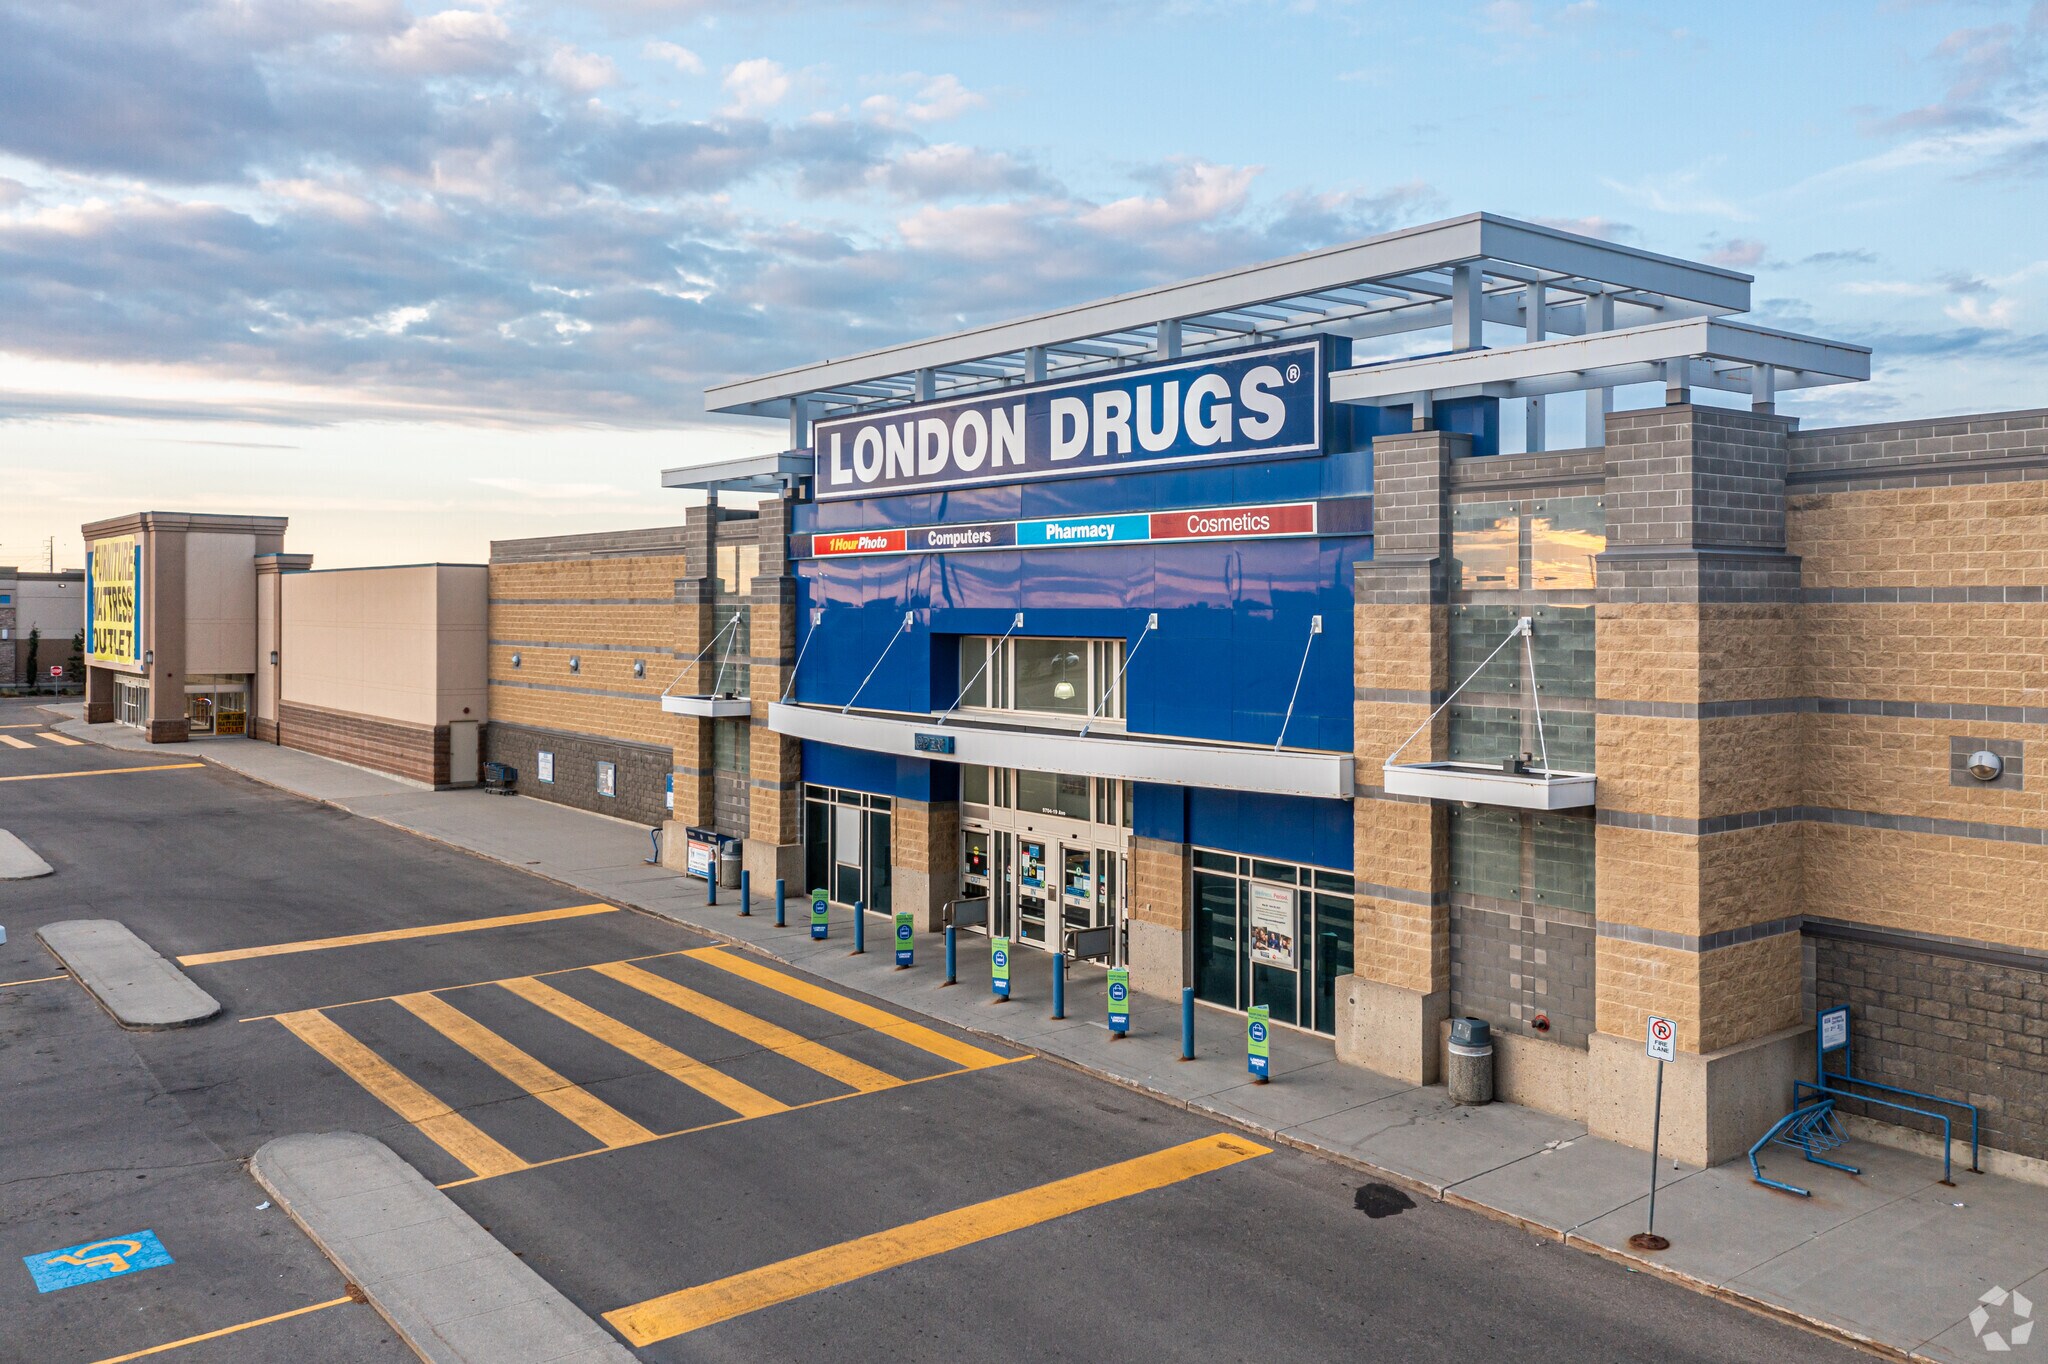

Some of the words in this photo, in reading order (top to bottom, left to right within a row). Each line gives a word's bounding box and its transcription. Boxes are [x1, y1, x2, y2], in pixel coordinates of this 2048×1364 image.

[831, 404, 1025, 485] LONDON
[1187, 512, 1270, 533] Cosmetics
[928, 530, 991, 547] Computers
[1046, 523, 1115, 540] Pharmacy
[95, 541, 134, 581] FURNITURE
[93, 628, 132, 657] OUTLET
[1030, 888, 1037, 896] IN
[1273, 893, 1289, 901] Period.
[1652, 1045, 1670, 1054] LANE
